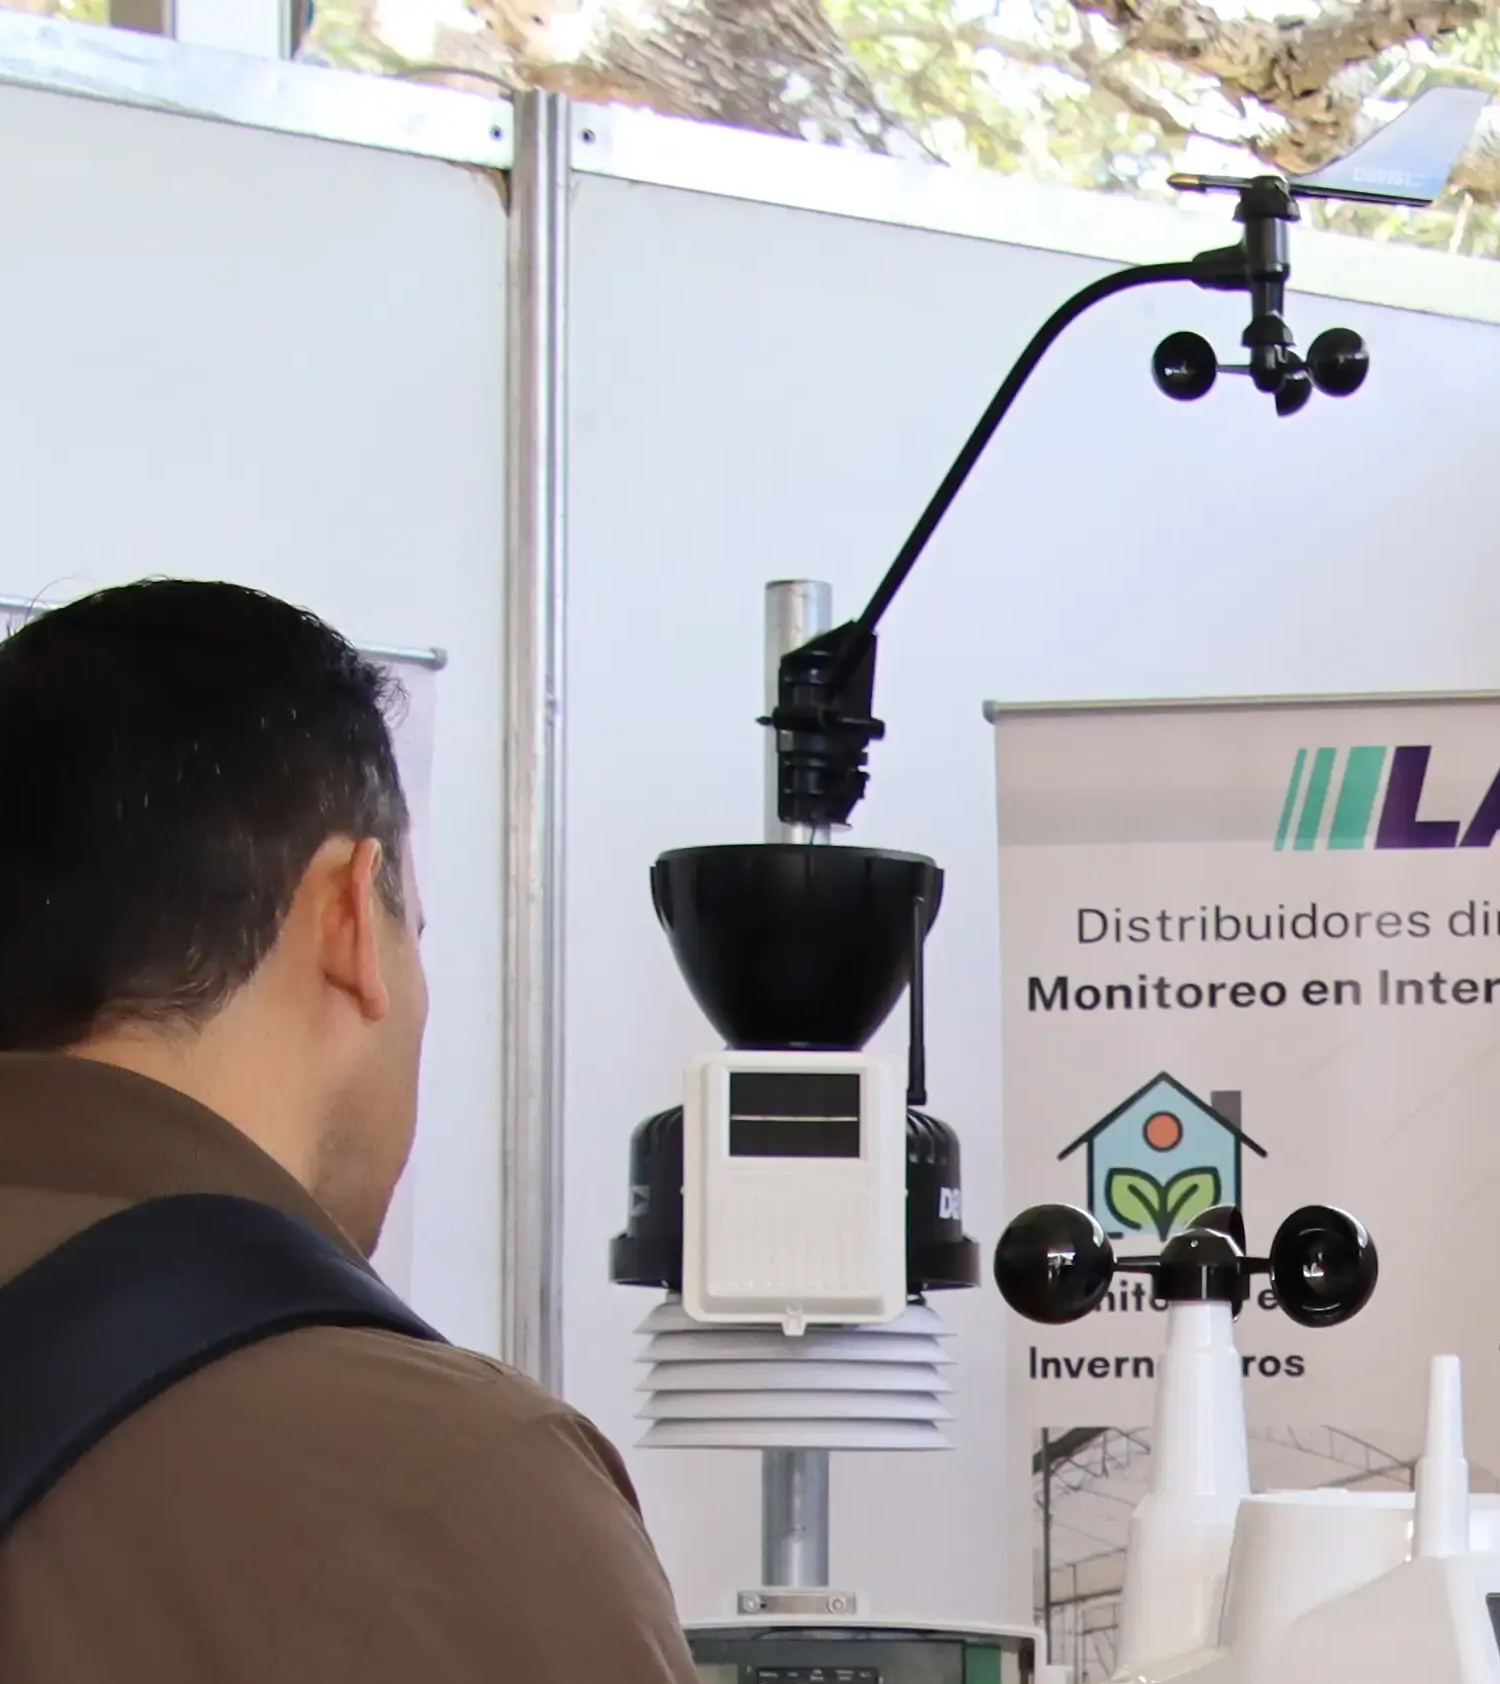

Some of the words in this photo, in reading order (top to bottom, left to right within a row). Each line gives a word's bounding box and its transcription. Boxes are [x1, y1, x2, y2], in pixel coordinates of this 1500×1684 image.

[1077, 902, 1431, 944] Distribuidores
[1028, 973, 1287, 1012] Monitoreo
[1301, 979, 1361, 1008] en
